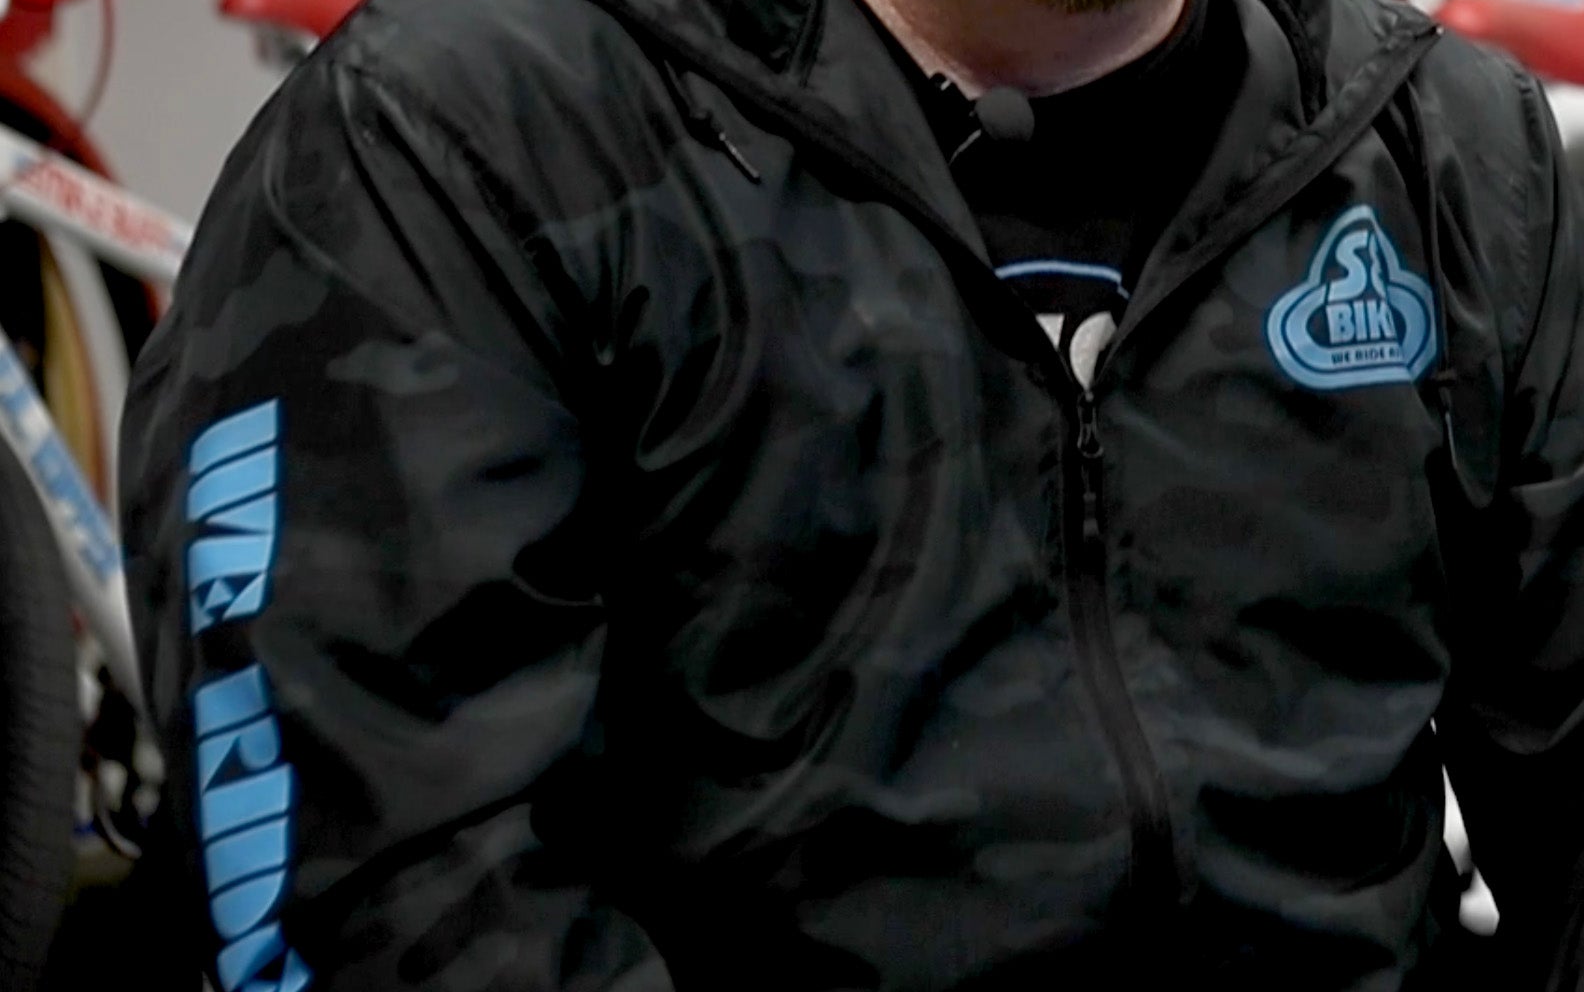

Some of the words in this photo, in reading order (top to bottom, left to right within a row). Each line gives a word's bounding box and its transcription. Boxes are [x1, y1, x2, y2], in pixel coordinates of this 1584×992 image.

[1328, 230, 1388, 304] S
[1326, 299, 1397, 345] BIK
[188, 398, 279, 638] WE
